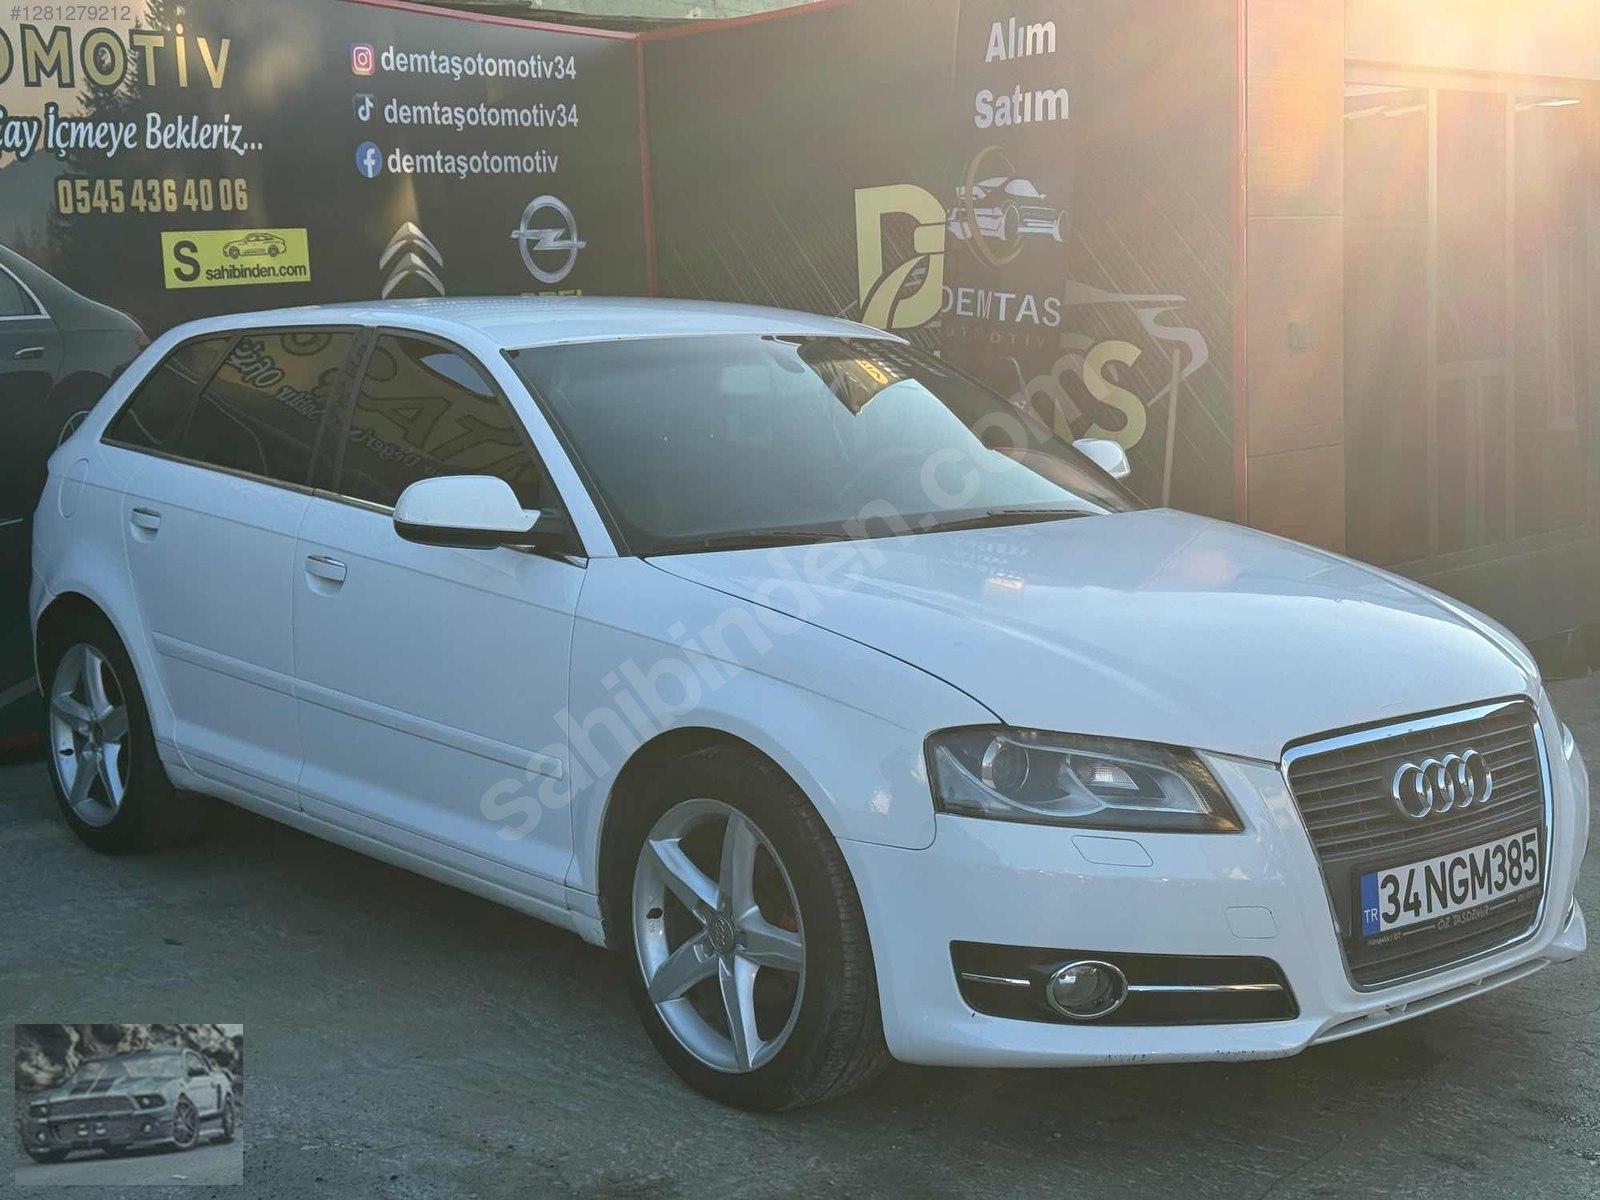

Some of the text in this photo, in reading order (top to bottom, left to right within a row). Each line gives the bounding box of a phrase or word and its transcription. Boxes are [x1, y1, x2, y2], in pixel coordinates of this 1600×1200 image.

[985, 17, 1056, 62] Alım
[381, 46, 577, 81] demtaşotomotiv34
[384, 99, 579, 131] demtaşotomotiv34
[974, 85, 1069, 129] Satım
[47, 106, 138, 158] İçmeye
[387, 148, 559, 179] demtaşotomotiv
[57, 178, 249, 214] 0545 436 40 06
[205, 263, 307, 281] sahibinden.com
[1364, 833, 1537, 924] TR 34NGM385
